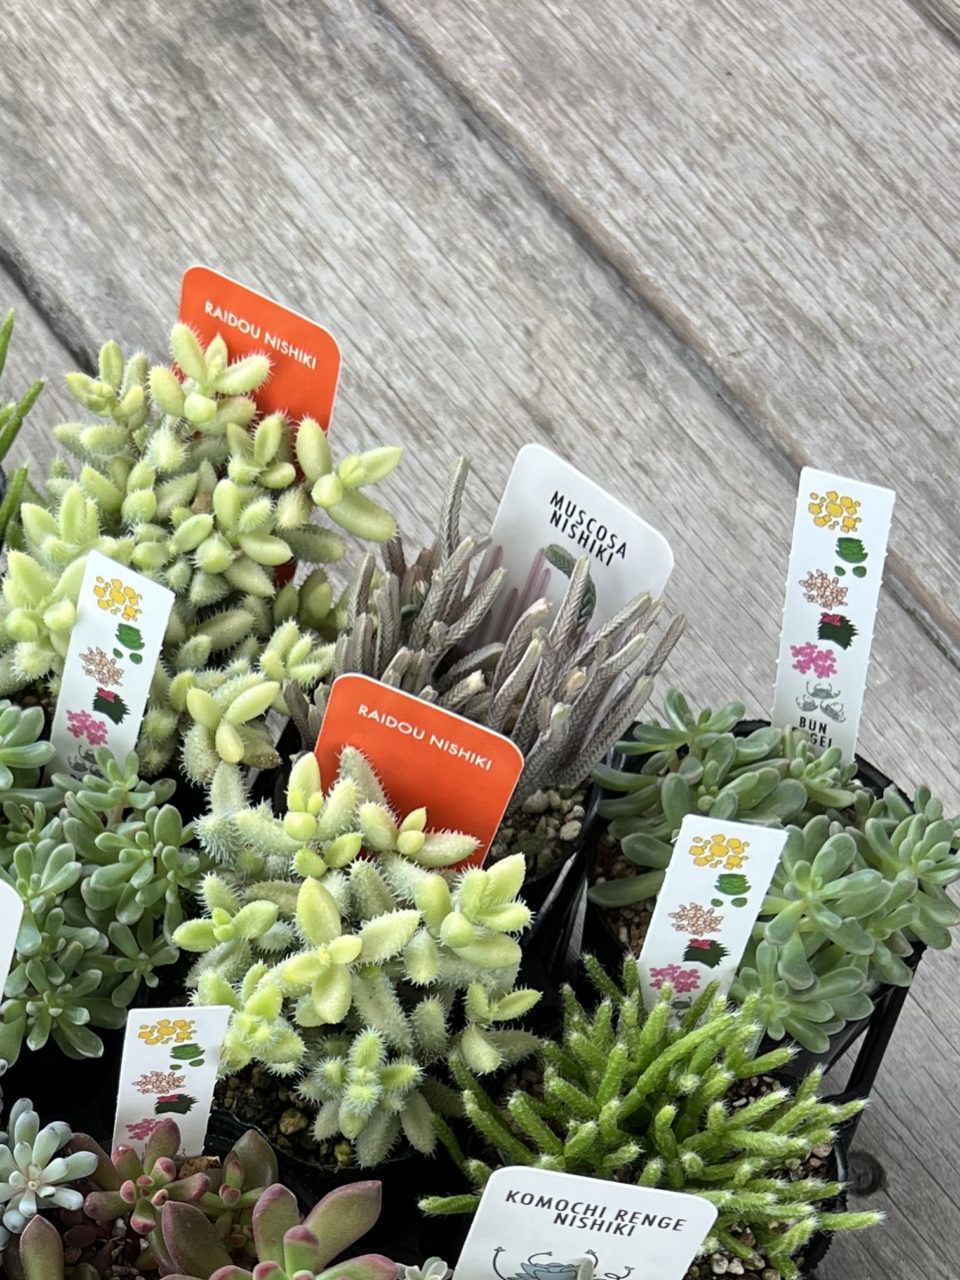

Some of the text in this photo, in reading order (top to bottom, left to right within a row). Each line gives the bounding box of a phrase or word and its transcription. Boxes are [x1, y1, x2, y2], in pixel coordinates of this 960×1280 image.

[204, 300, 317, 370] RAIDOU NISHIKI
[549, 490, 627, 559] MUSCOSA
[549, 509, 614, 566] NISHIKI
[358, 704, 493, 771] RAIDOU NISHIKI
[798, 715, 828, 736] BUN
[505, 1190, 687, 1232] KOMOCHI RENGE
[553, 1212, 636, 1237] NISHIKI
